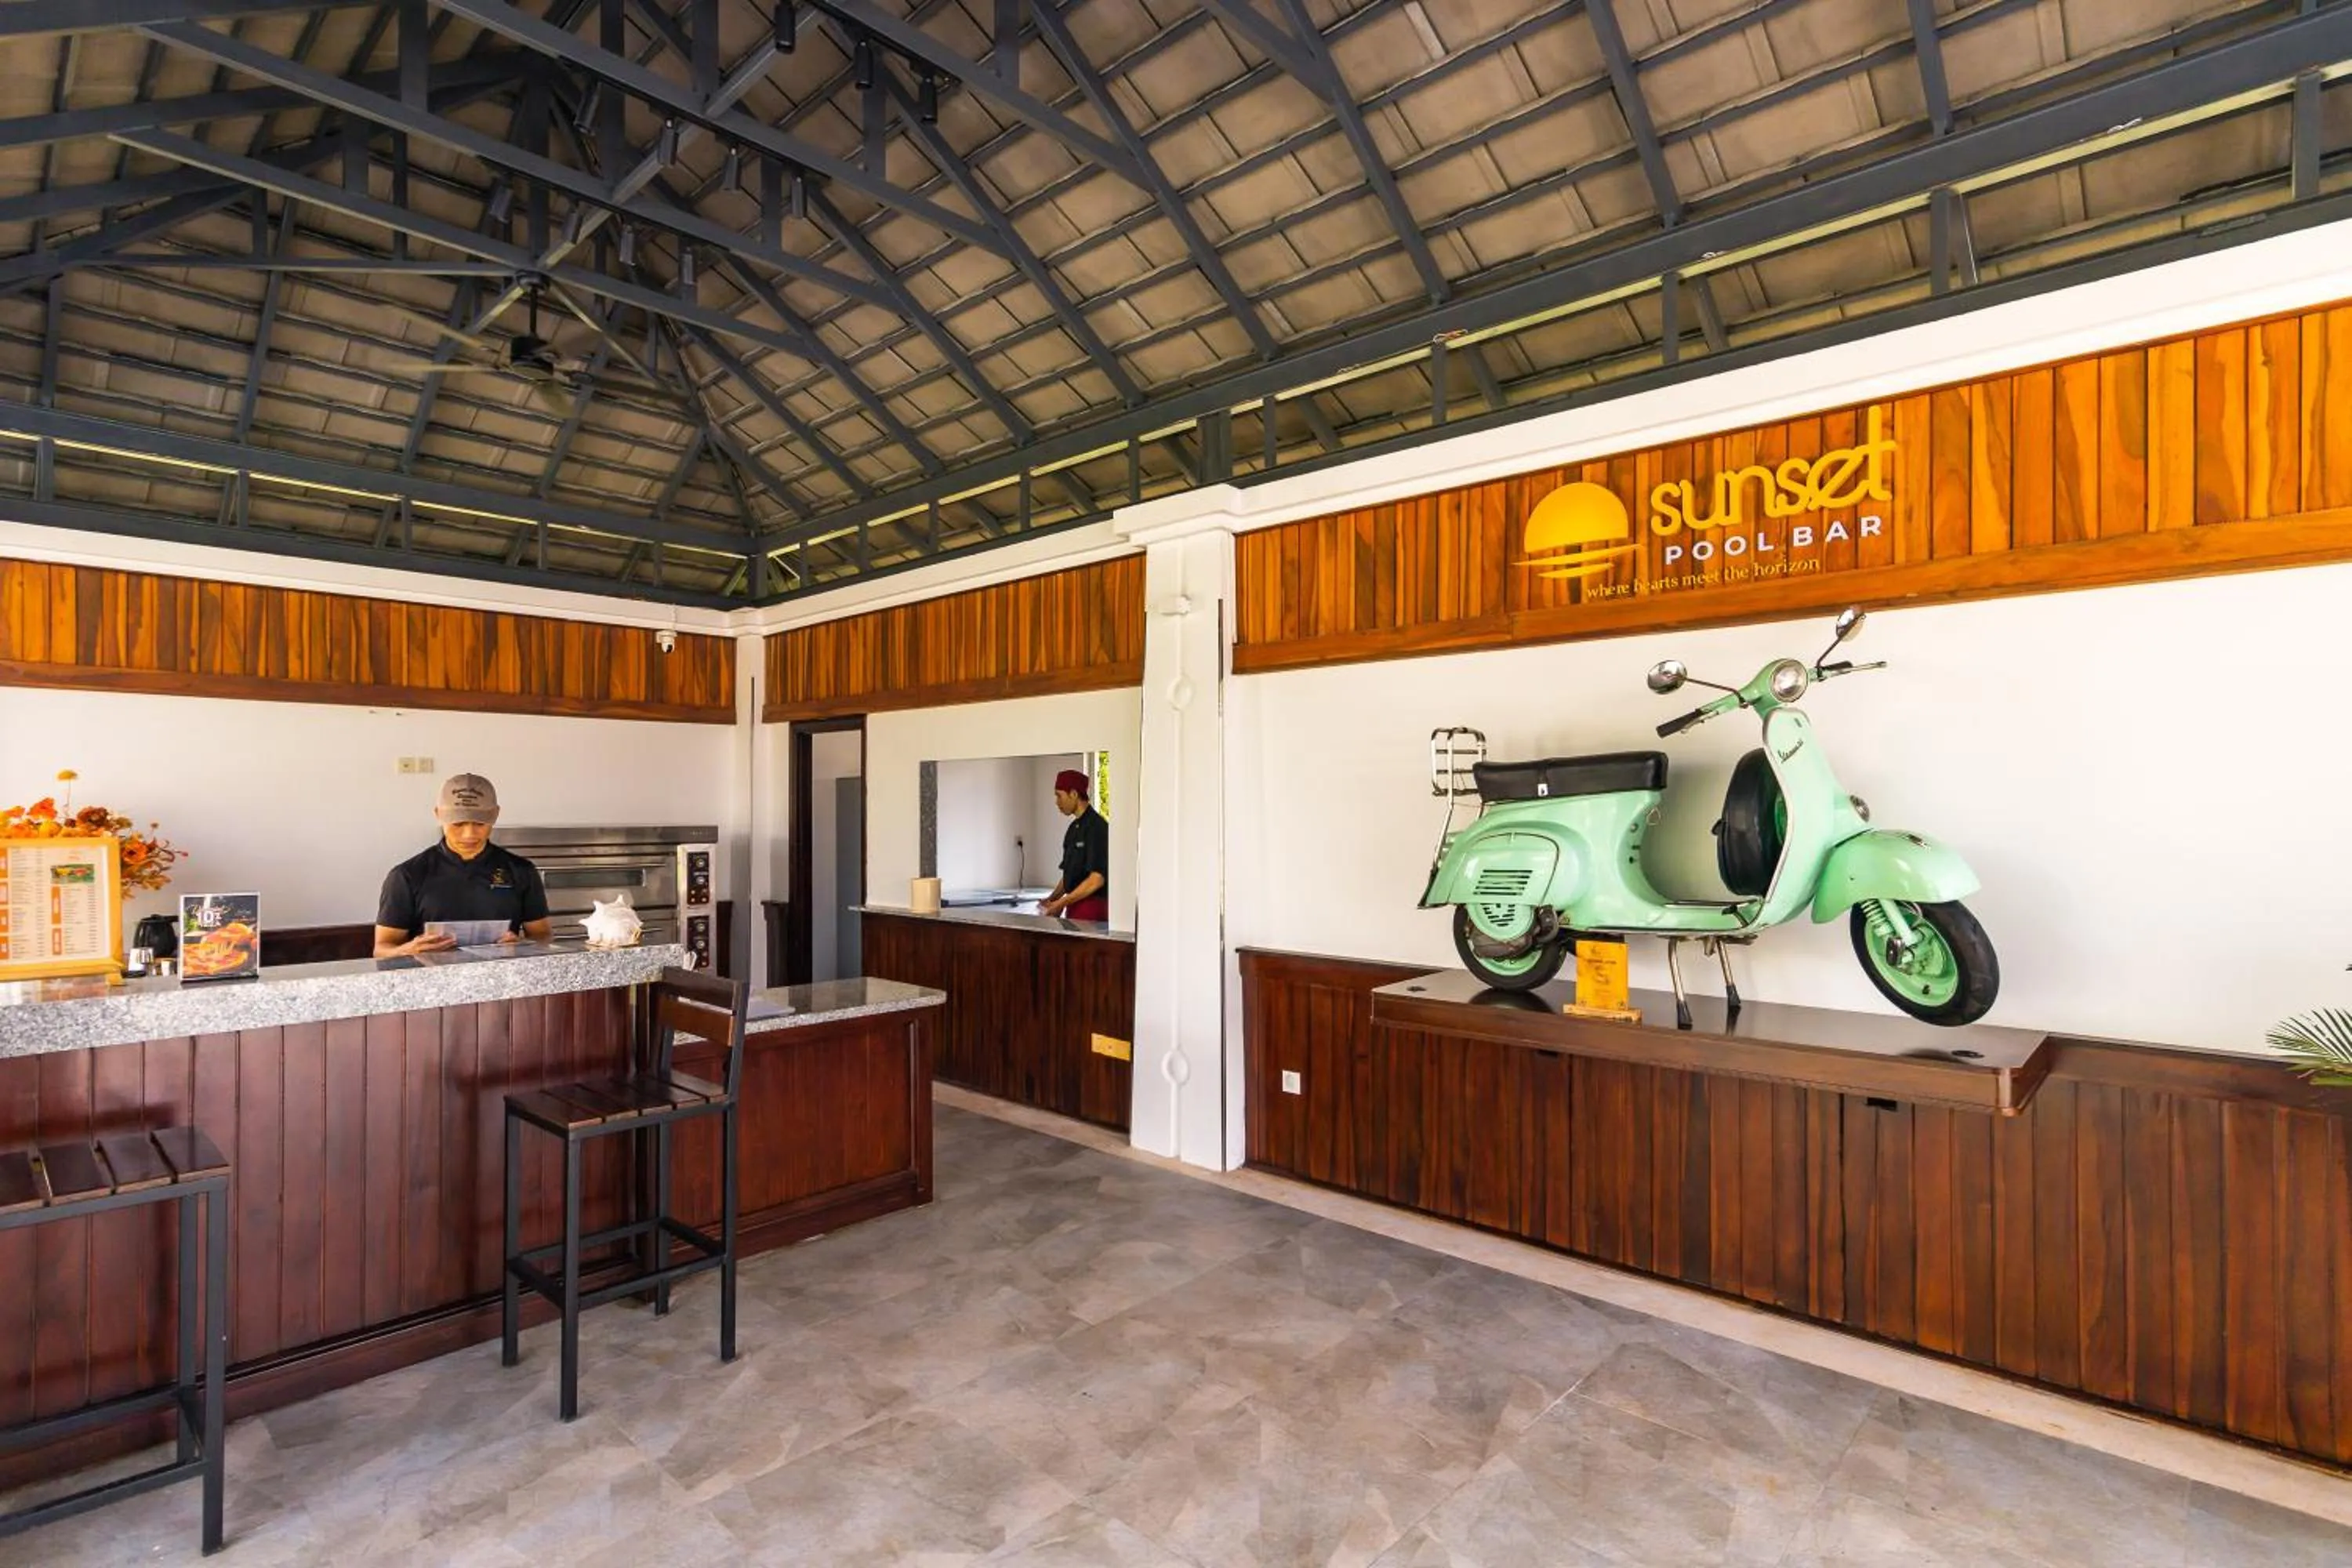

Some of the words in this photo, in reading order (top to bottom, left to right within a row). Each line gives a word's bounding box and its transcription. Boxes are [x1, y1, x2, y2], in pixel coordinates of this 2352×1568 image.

[1650, 405, 1896, 536] sunset
[1665, 532, 1774, 565] POOL
[1793, 514, 1882, 547] BAR
[1588, 583, 1631, 598] where
[1632, 574, 1679, 593] hearts
[1681, 571, 1720, 586] meet
[1724, 564, 1749, 580] the
[1752, 557, 1820, 577] horizon
